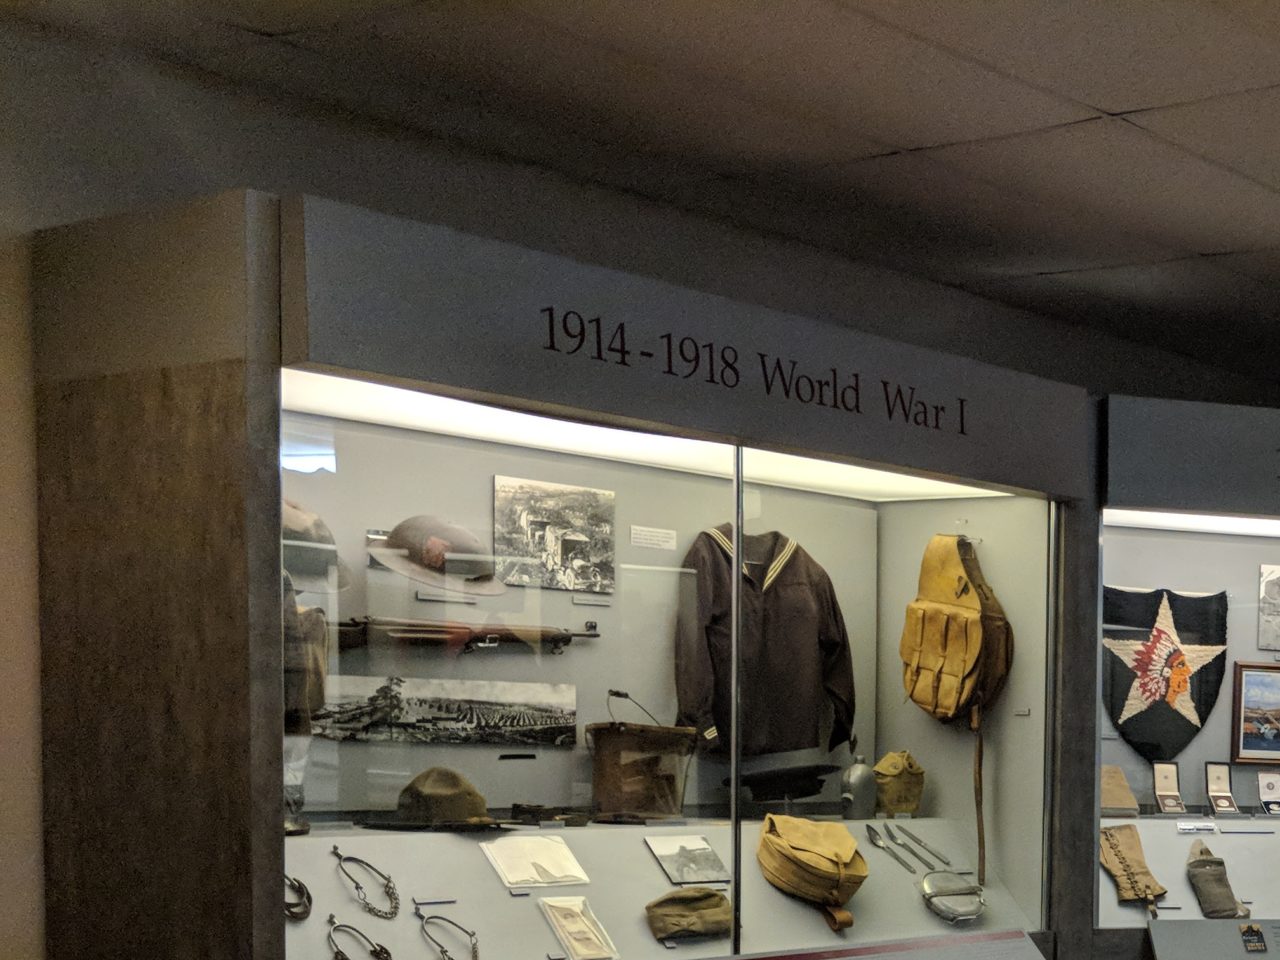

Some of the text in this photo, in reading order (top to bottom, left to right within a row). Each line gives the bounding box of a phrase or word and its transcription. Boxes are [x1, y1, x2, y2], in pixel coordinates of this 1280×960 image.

[540, 306, 969, 436] 1914-1918 World War I
